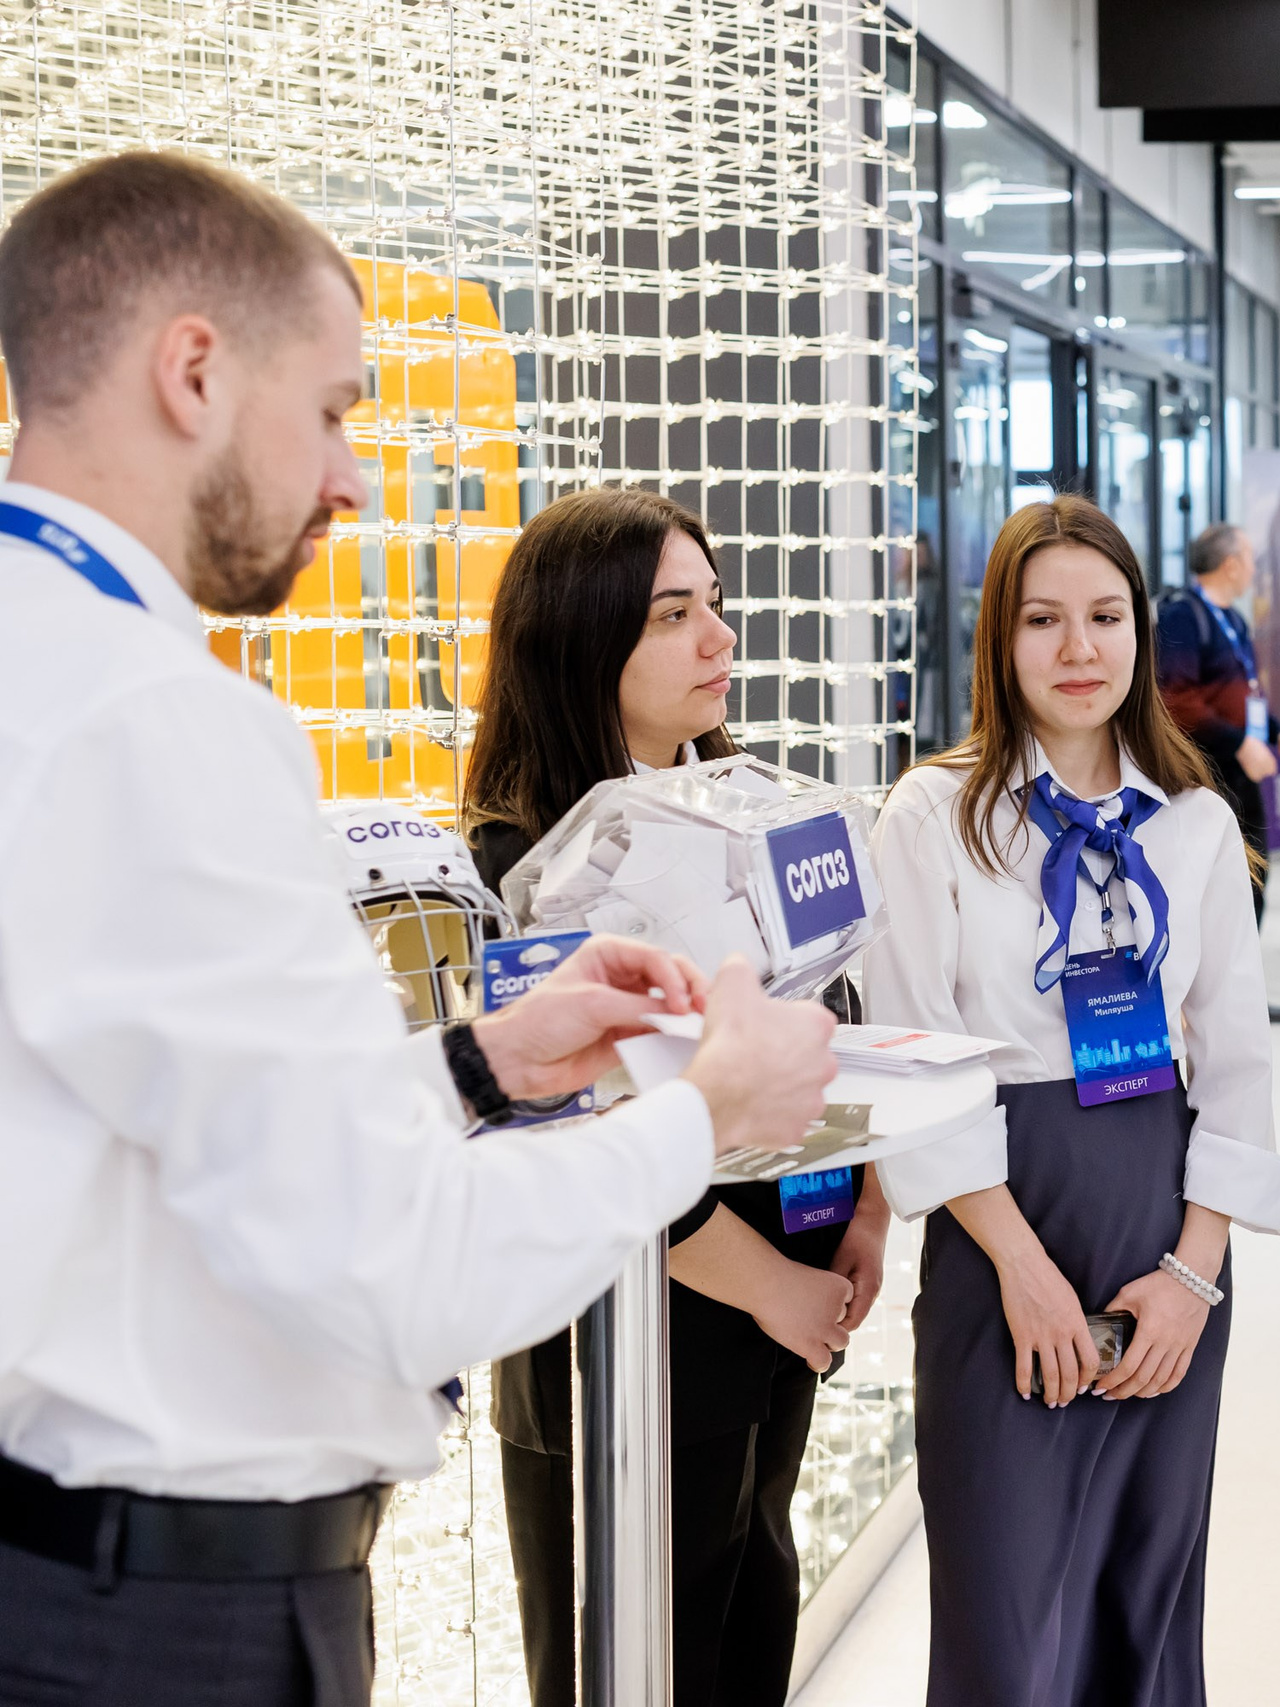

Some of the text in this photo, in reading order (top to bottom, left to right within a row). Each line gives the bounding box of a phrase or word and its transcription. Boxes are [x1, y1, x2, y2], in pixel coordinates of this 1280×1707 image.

[347, 821, 441, 843] согаз
[785, 848, 850, 903] согаз
[1065, 966, 1101, 978] ИНВЕСТОРА
[1087, 991, 1138, 1008] ЯМАЛИЕВА
[1094, 1004, 1134, 1017] Миляуша
[1104, 1077, 1149, 1095] ЭКСПЕРТ
[802, 1207, 835, 1224] ЭКСПЕРТ
